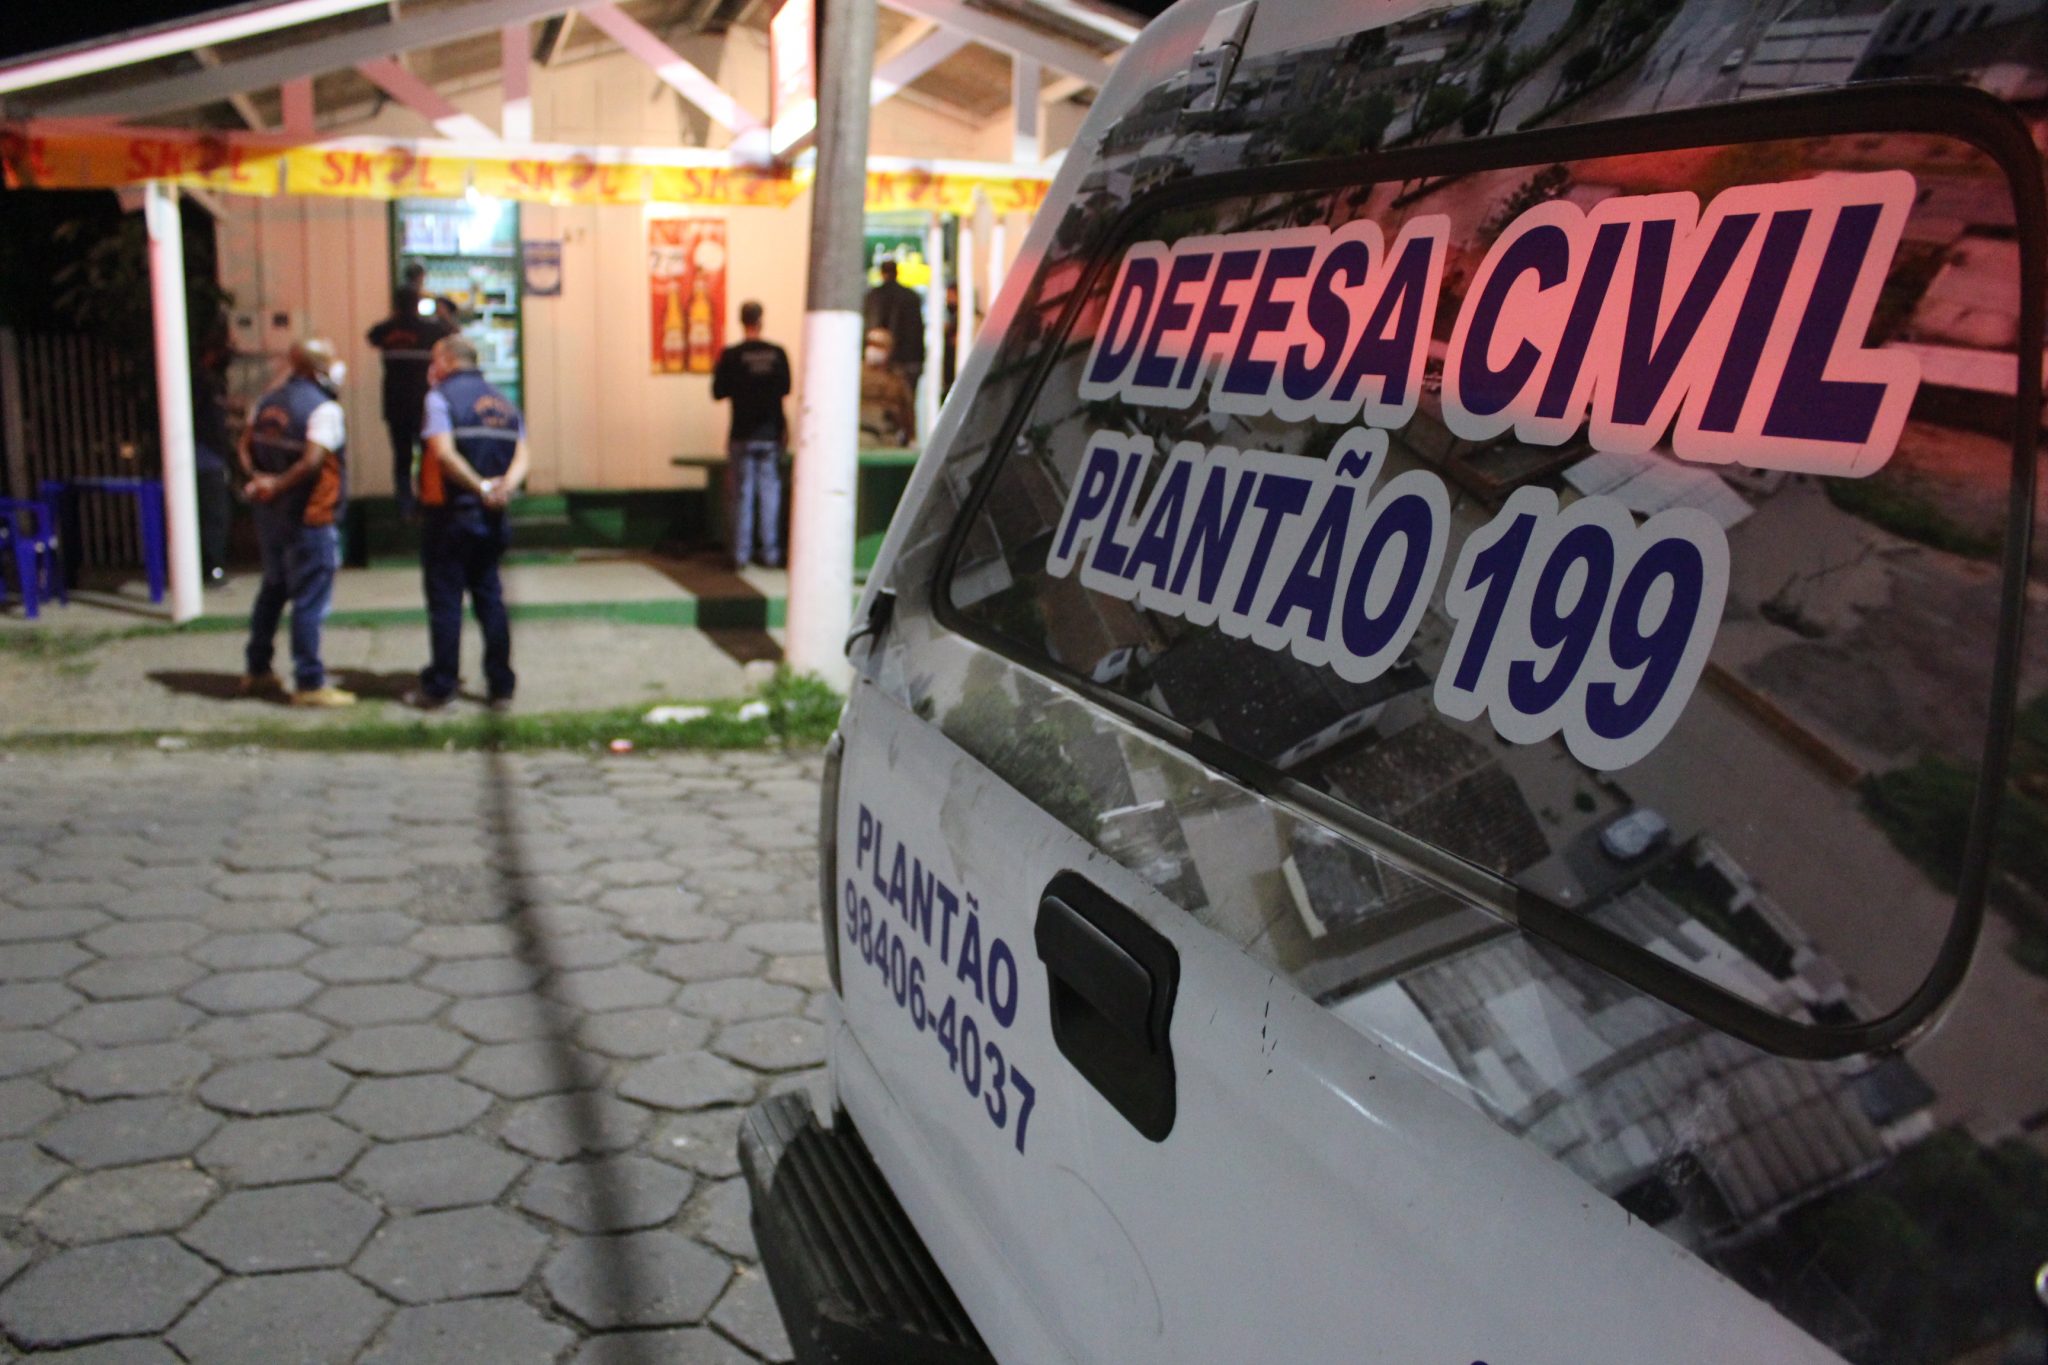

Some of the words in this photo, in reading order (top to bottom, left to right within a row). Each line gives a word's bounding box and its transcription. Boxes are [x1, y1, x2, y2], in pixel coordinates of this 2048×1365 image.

[319, 146, 437, 187] SKOL
[1088, 236, 1434, 406] DEFESA
[1457, 203, 1886, 444] CIVIL
[1057, 446, 1435, 658] PLANTÃO
[1453, 512, 1704, 740] 199
[845, 878, 1035, 1156] 98406-4037
[857, 803, 1018, 1028] PLANTÃO
